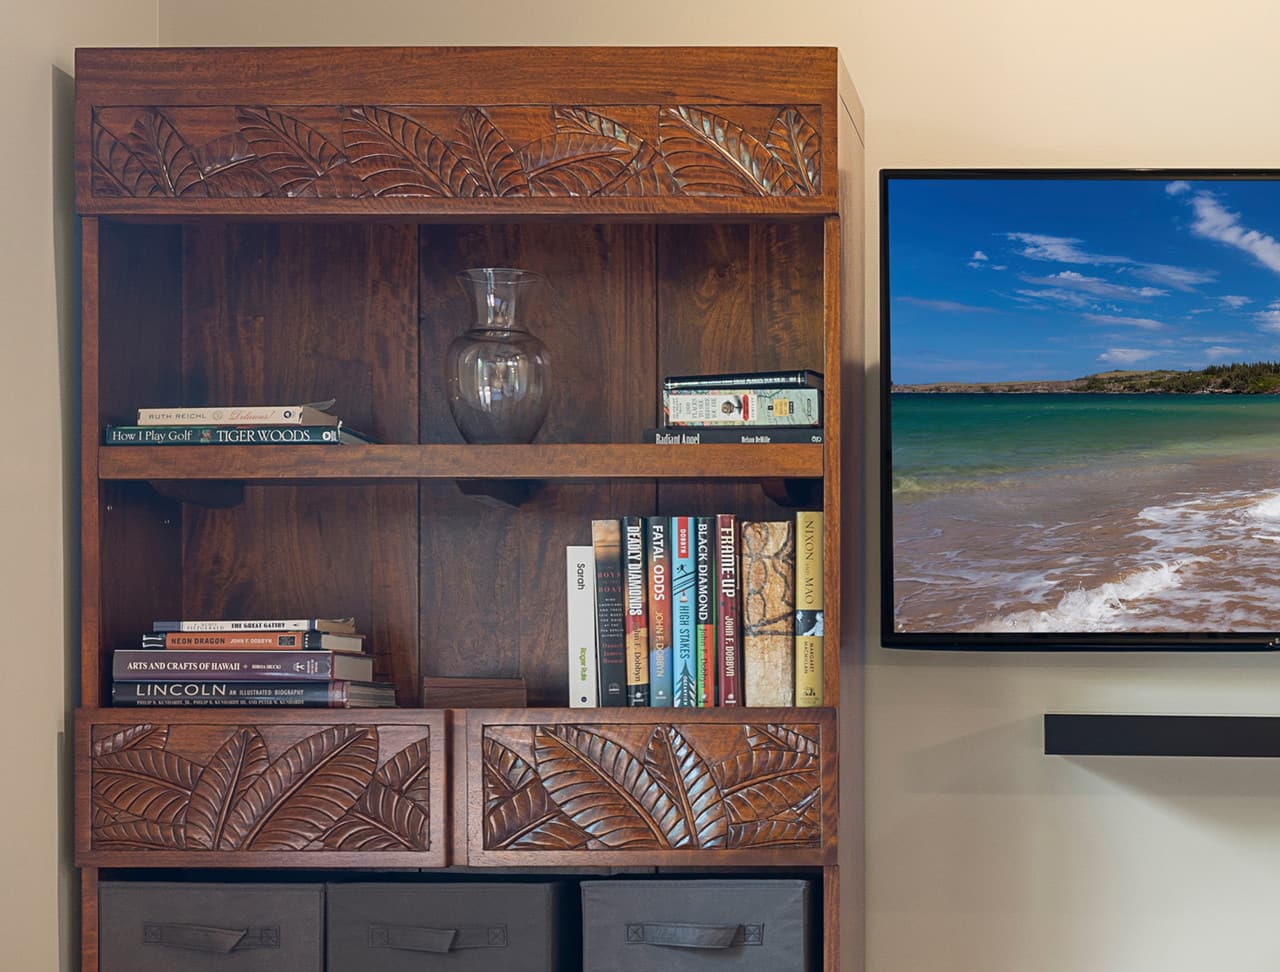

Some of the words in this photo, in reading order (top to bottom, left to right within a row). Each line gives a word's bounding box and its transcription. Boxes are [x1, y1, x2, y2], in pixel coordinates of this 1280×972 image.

[148, 412, 172, 420] RUTH
[175, 411, 207, 419] REICHL
[112, 430, 136, 441] How
[145, 430, 166, 444] Play
[168, 429, 193, 441] Golf
[216, 429, 256, 442] TIGER
[257, 429, 311, 442] WOODS
[655, 433, 681, 445] Radiant
[626, 525, 642, 560] DEADLY
[652, 525, 664, 562] FATAL
[698, 523, 708, 561] BLACK
[805, 520, 815, 561] NIXON
[720, 521, 735, 598] FRAME-UP
[576, 563, 586, 590] Sarah
[627, 563, 643, 616] DIAMONDS
[653, 564, 665, 601] ODDS
[698, 565, 708, 620] DIAMOND
[805, 577, 815, 605] MAO
[655, 611, 664, 634] JOHN
[679, 605, 690, 625] HIGH
[725, 615, 735, 636] JOHN
[171, 637, 193, 645] NEON
[194, 637, 225, 645] DRAGON
[679, 629, 690, 660] STAKES
[127, 662, 148, 670] ARTS
[148, 662, 165, 670] AND
[166, 662, 198, 671] CRAFTS
[198, 662, 210, 670] OF
[211, 662, 240, 671] HAWAII
[632, 652, 642, 682] Dobbyn
[655, 643, 664, 678] DOBBYN
[136, 684, 226, 696] LINCOLN
